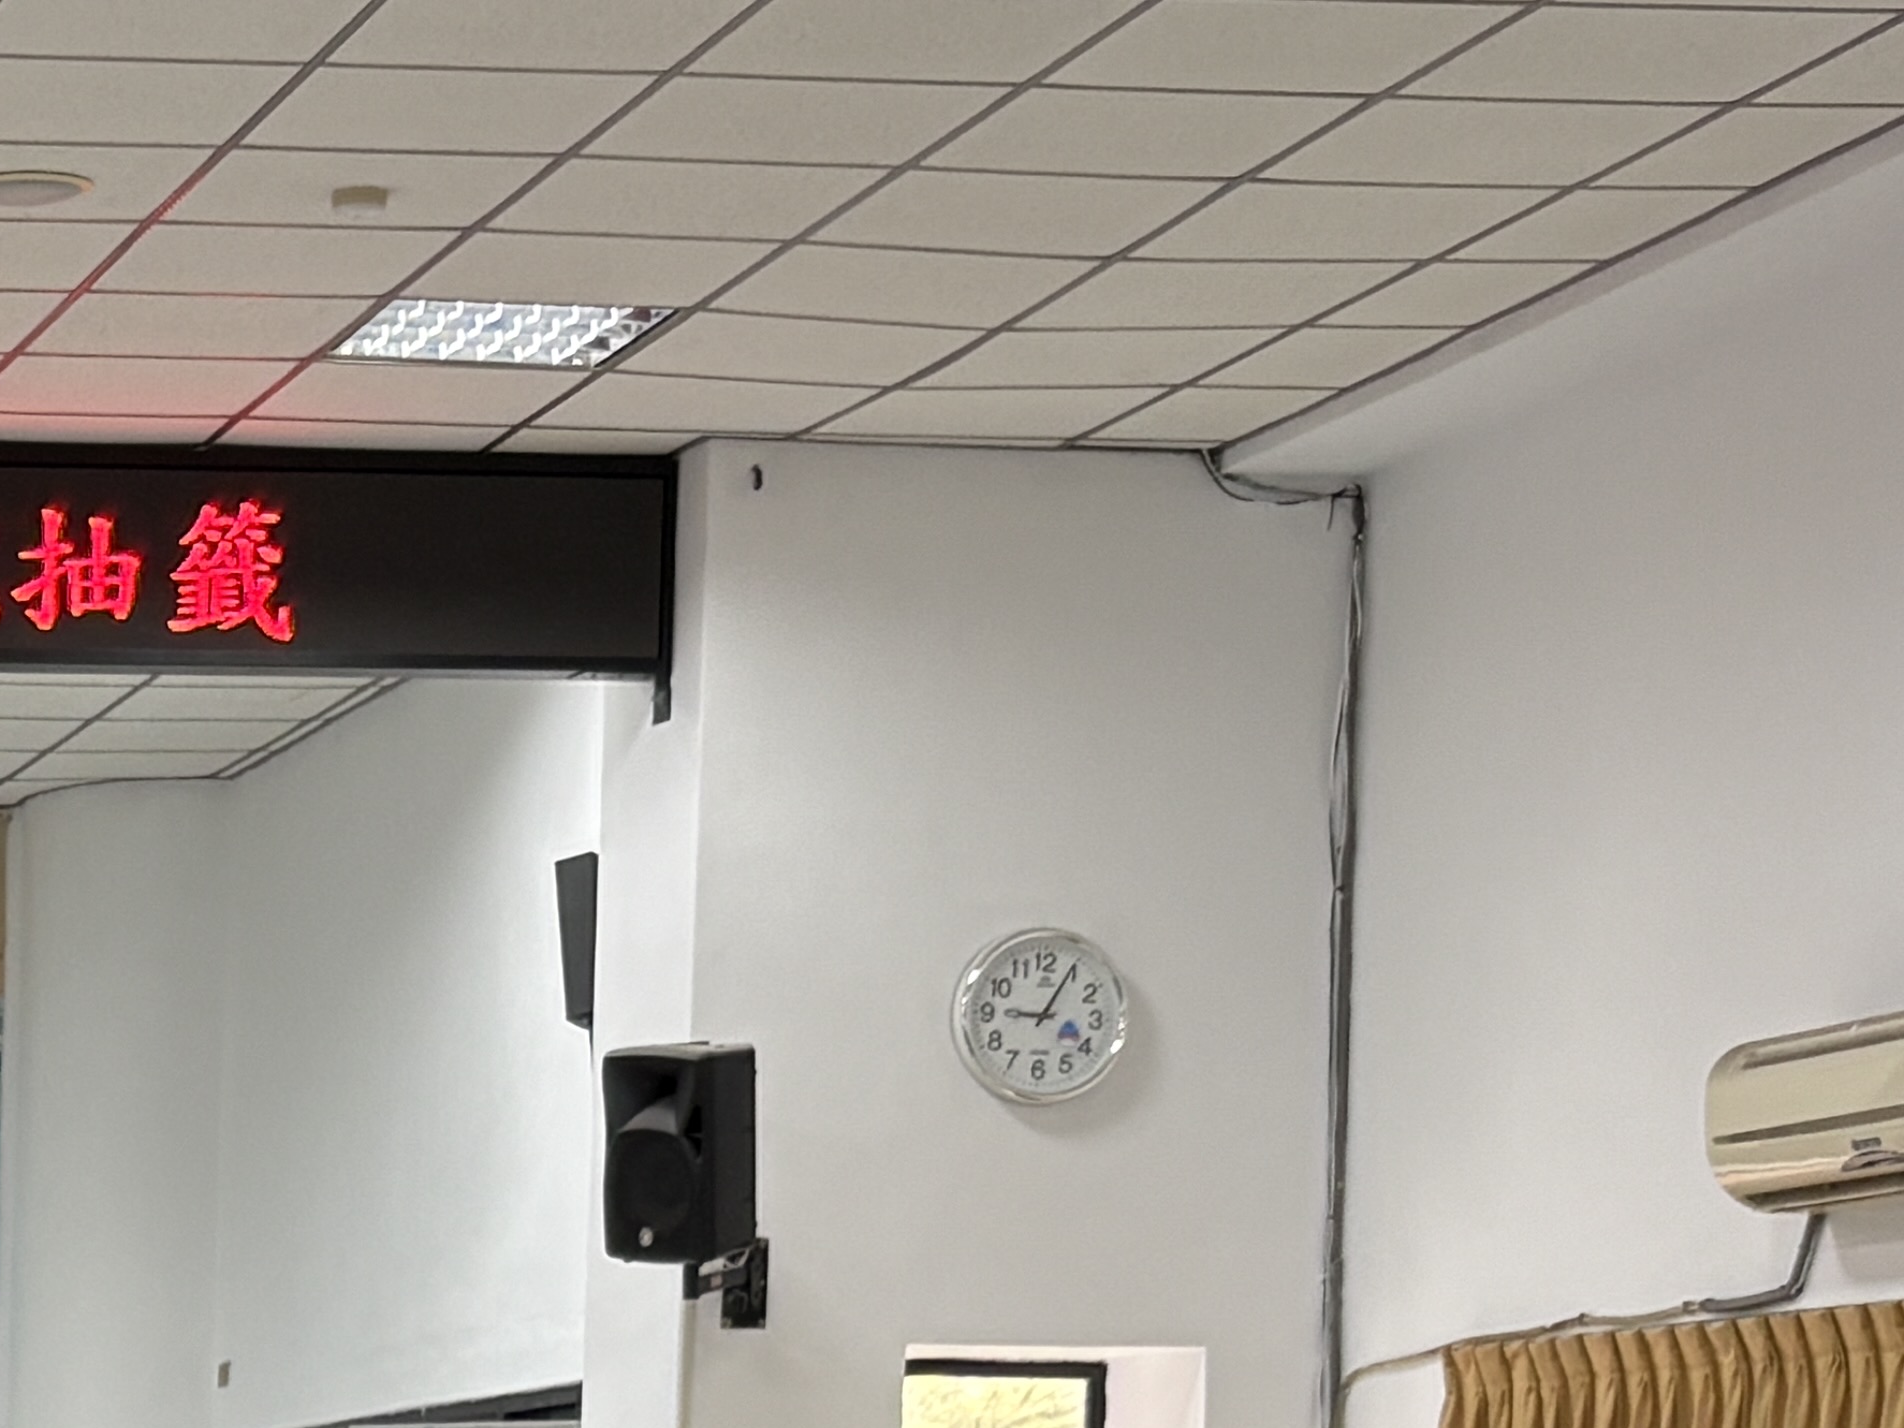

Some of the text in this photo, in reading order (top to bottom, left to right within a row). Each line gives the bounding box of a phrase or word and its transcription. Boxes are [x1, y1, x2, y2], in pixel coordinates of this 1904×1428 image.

[1012, 959, 1029, 979] 11
[1035, 952, 1057, 973] 12
[991, 977, 1012, 998] 10
[1082, 983, 1098, 1004] 2
[980, 1002, 995, 1023] 9
[1088, 1009, 1103, 1030] 3
[987, 1030, 1002, 1051] 8
[1077, 1037, 1092, 1056] 4
[1005, 1050, 1020, 1070] 7
[1031, 1059, 1046, 1080] 6
[1058, 1054, 1073, 1074] 5
